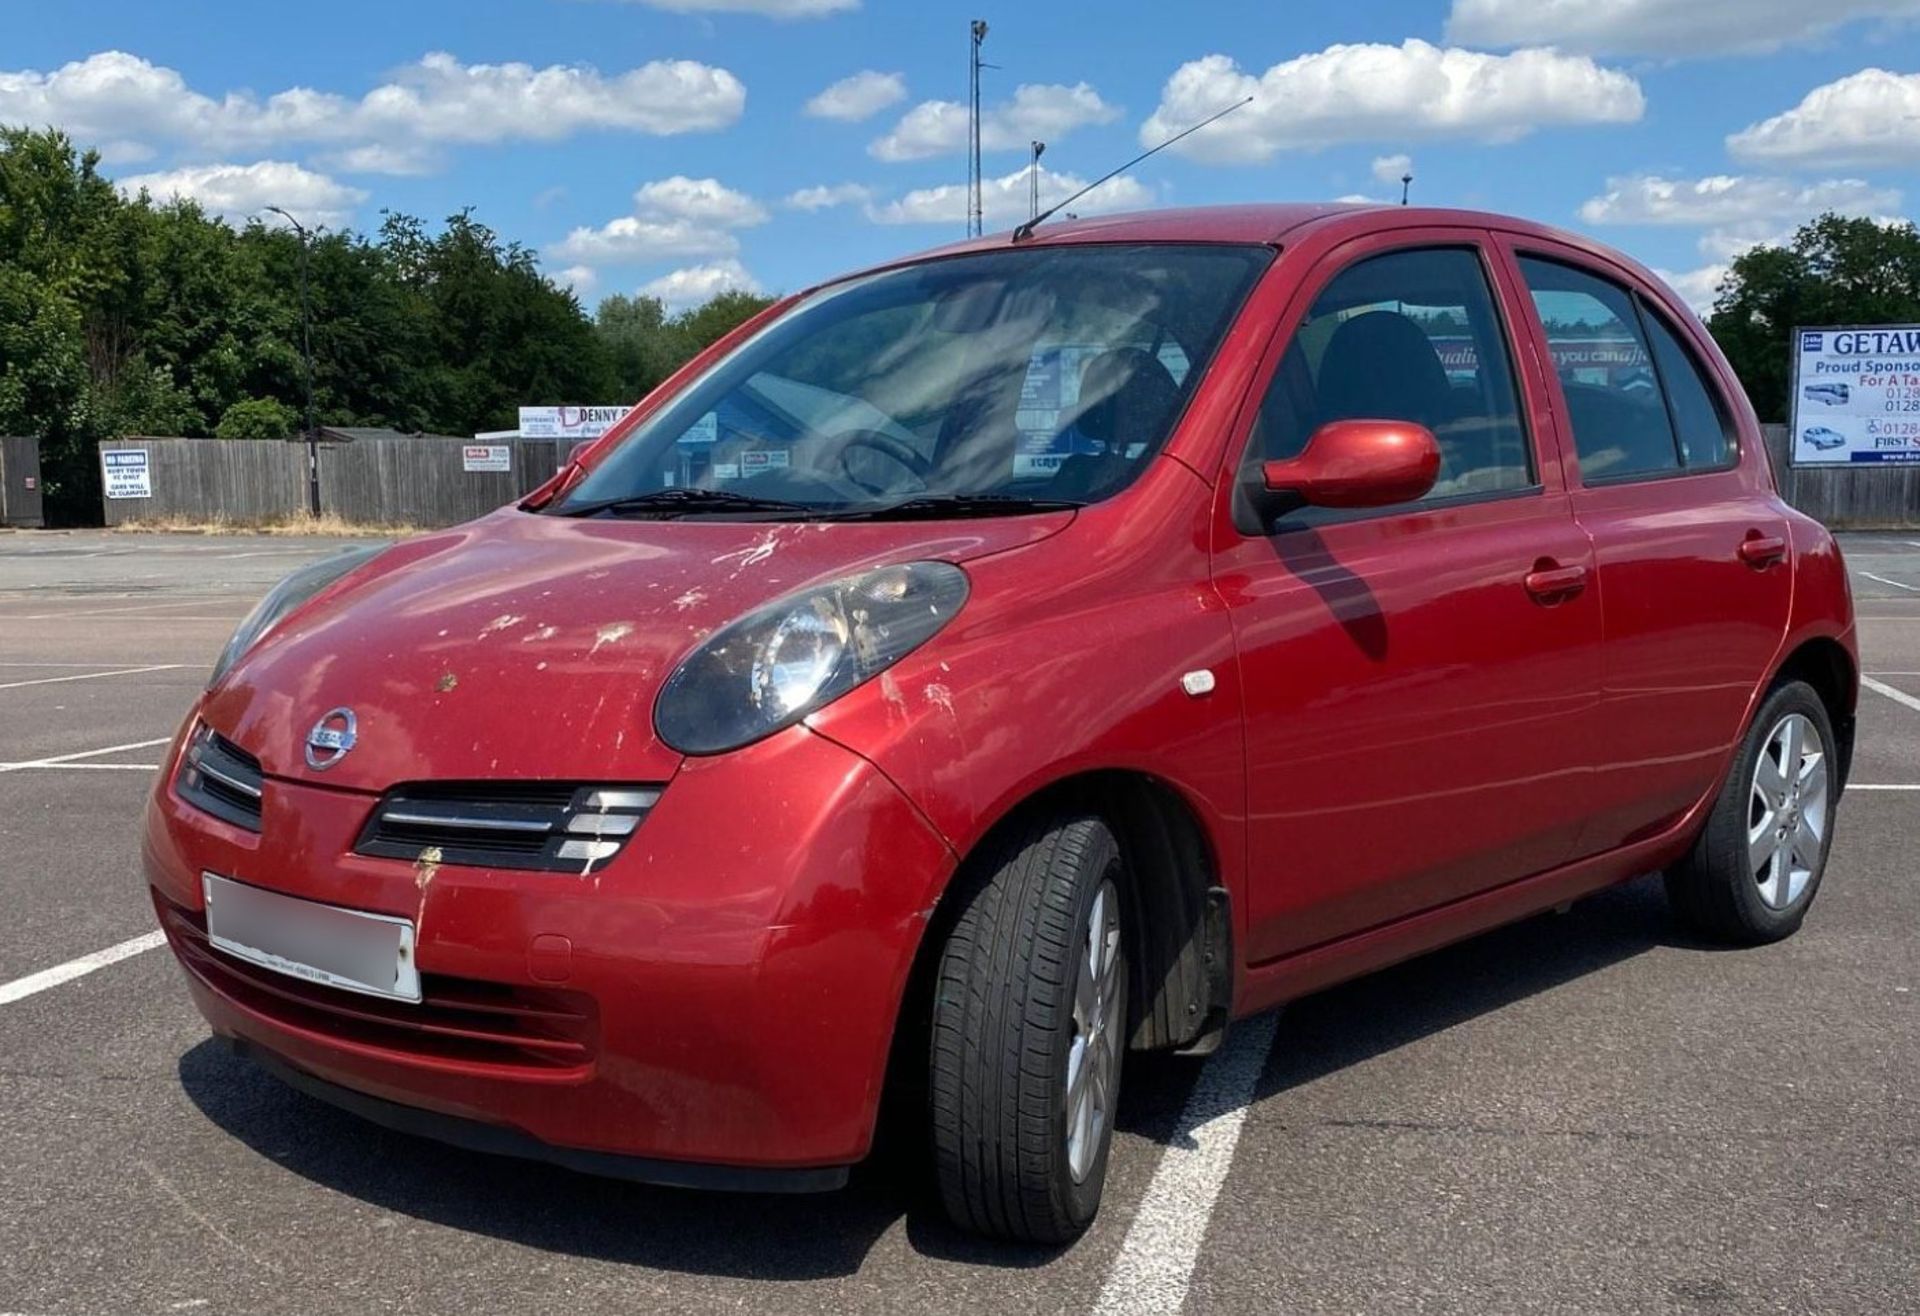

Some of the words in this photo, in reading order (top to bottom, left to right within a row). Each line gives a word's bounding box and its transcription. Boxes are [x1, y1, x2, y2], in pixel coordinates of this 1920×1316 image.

[1560, 351, 1589, 365] you
[1591, 351, 1618, 362] can
[1815, 361, 1860, 373] Proud
[1859, 374, 1884, 386] For
[1888, 374, 1898, 386] A
[1885, 400, 1920, 412] 0128
[580, 409, 618, 422] DENNY
[1875, 436, 1908, 448] FIRST
